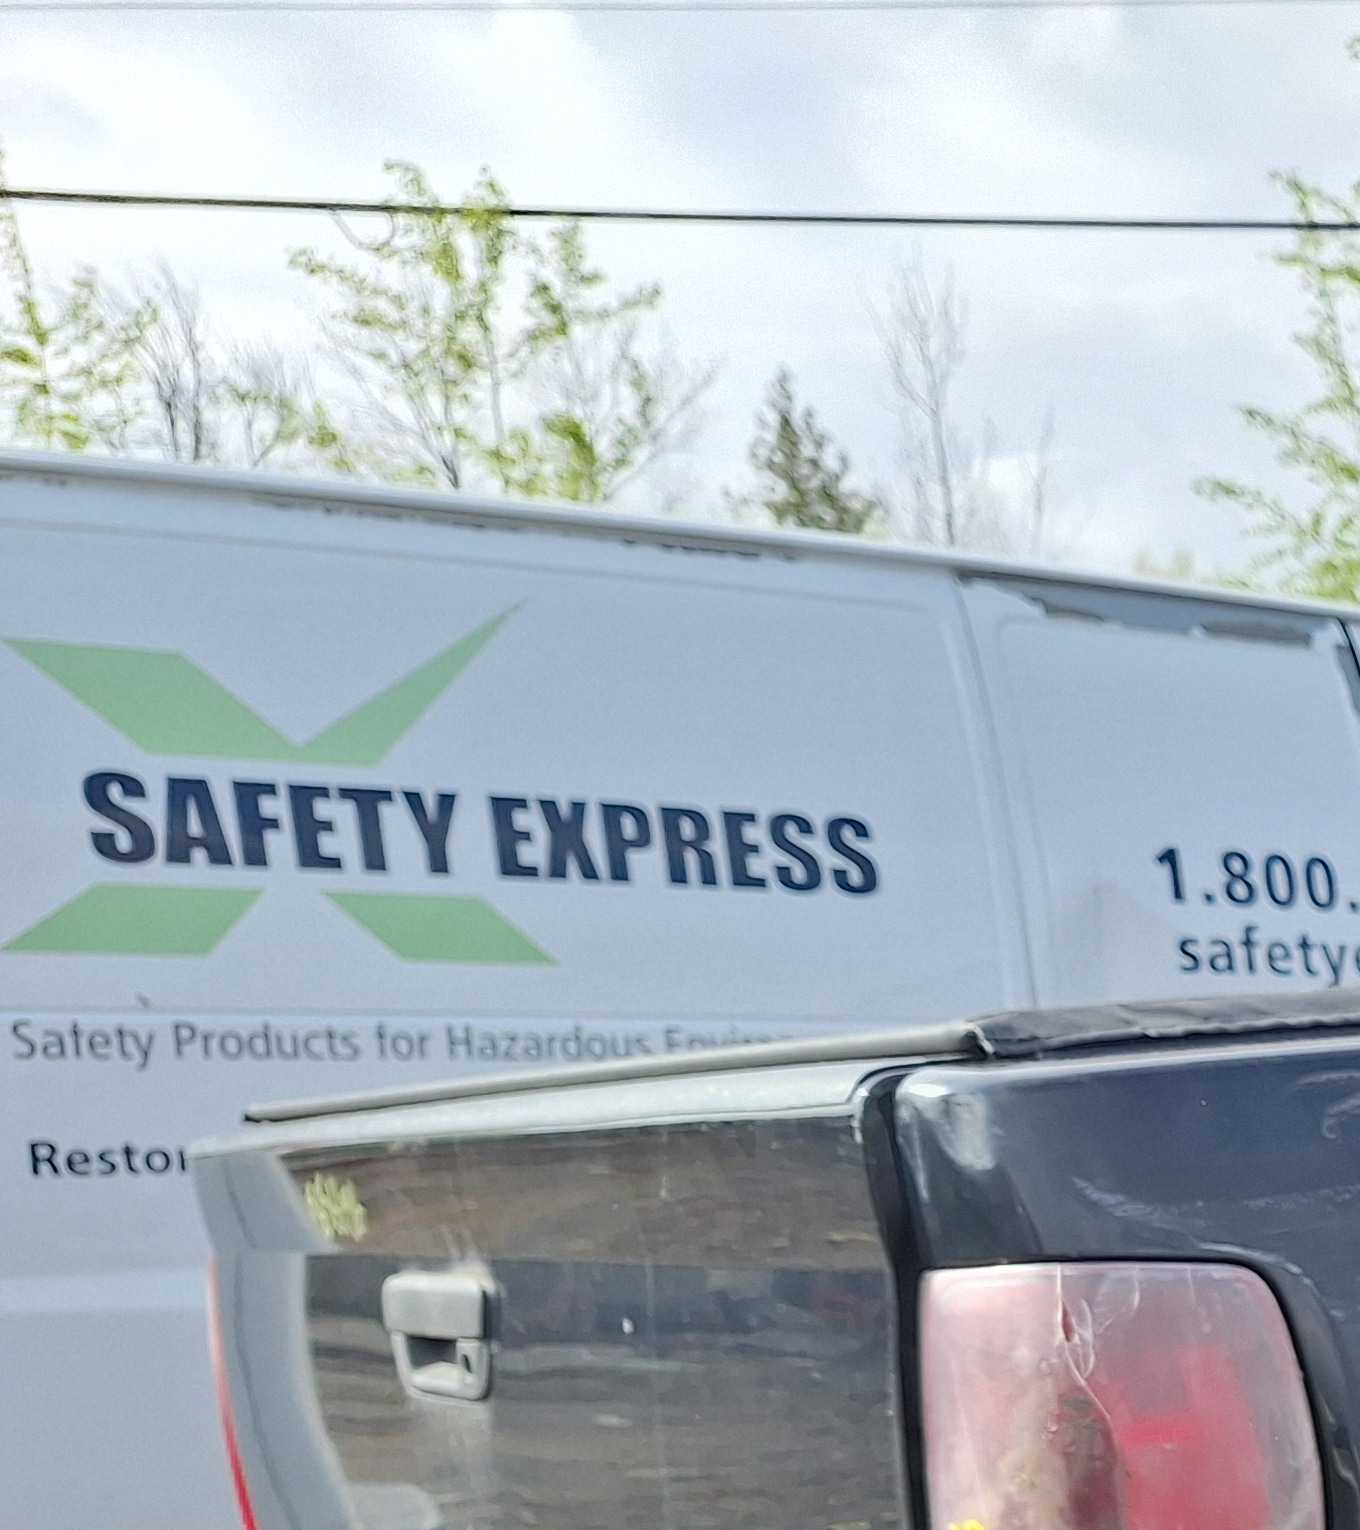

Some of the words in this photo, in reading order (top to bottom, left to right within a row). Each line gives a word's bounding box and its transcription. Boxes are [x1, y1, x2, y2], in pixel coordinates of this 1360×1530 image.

[82, 770, 459, 876] SAFETY
[489, 796, 881, 895] EXPRESS
[11, 1018, 154, 1071] Safety
[171, 1022, 360, 1061] Products
[376, 1025, 430, 1061] for
[447, 1028, 652, 1060] Hazardous
